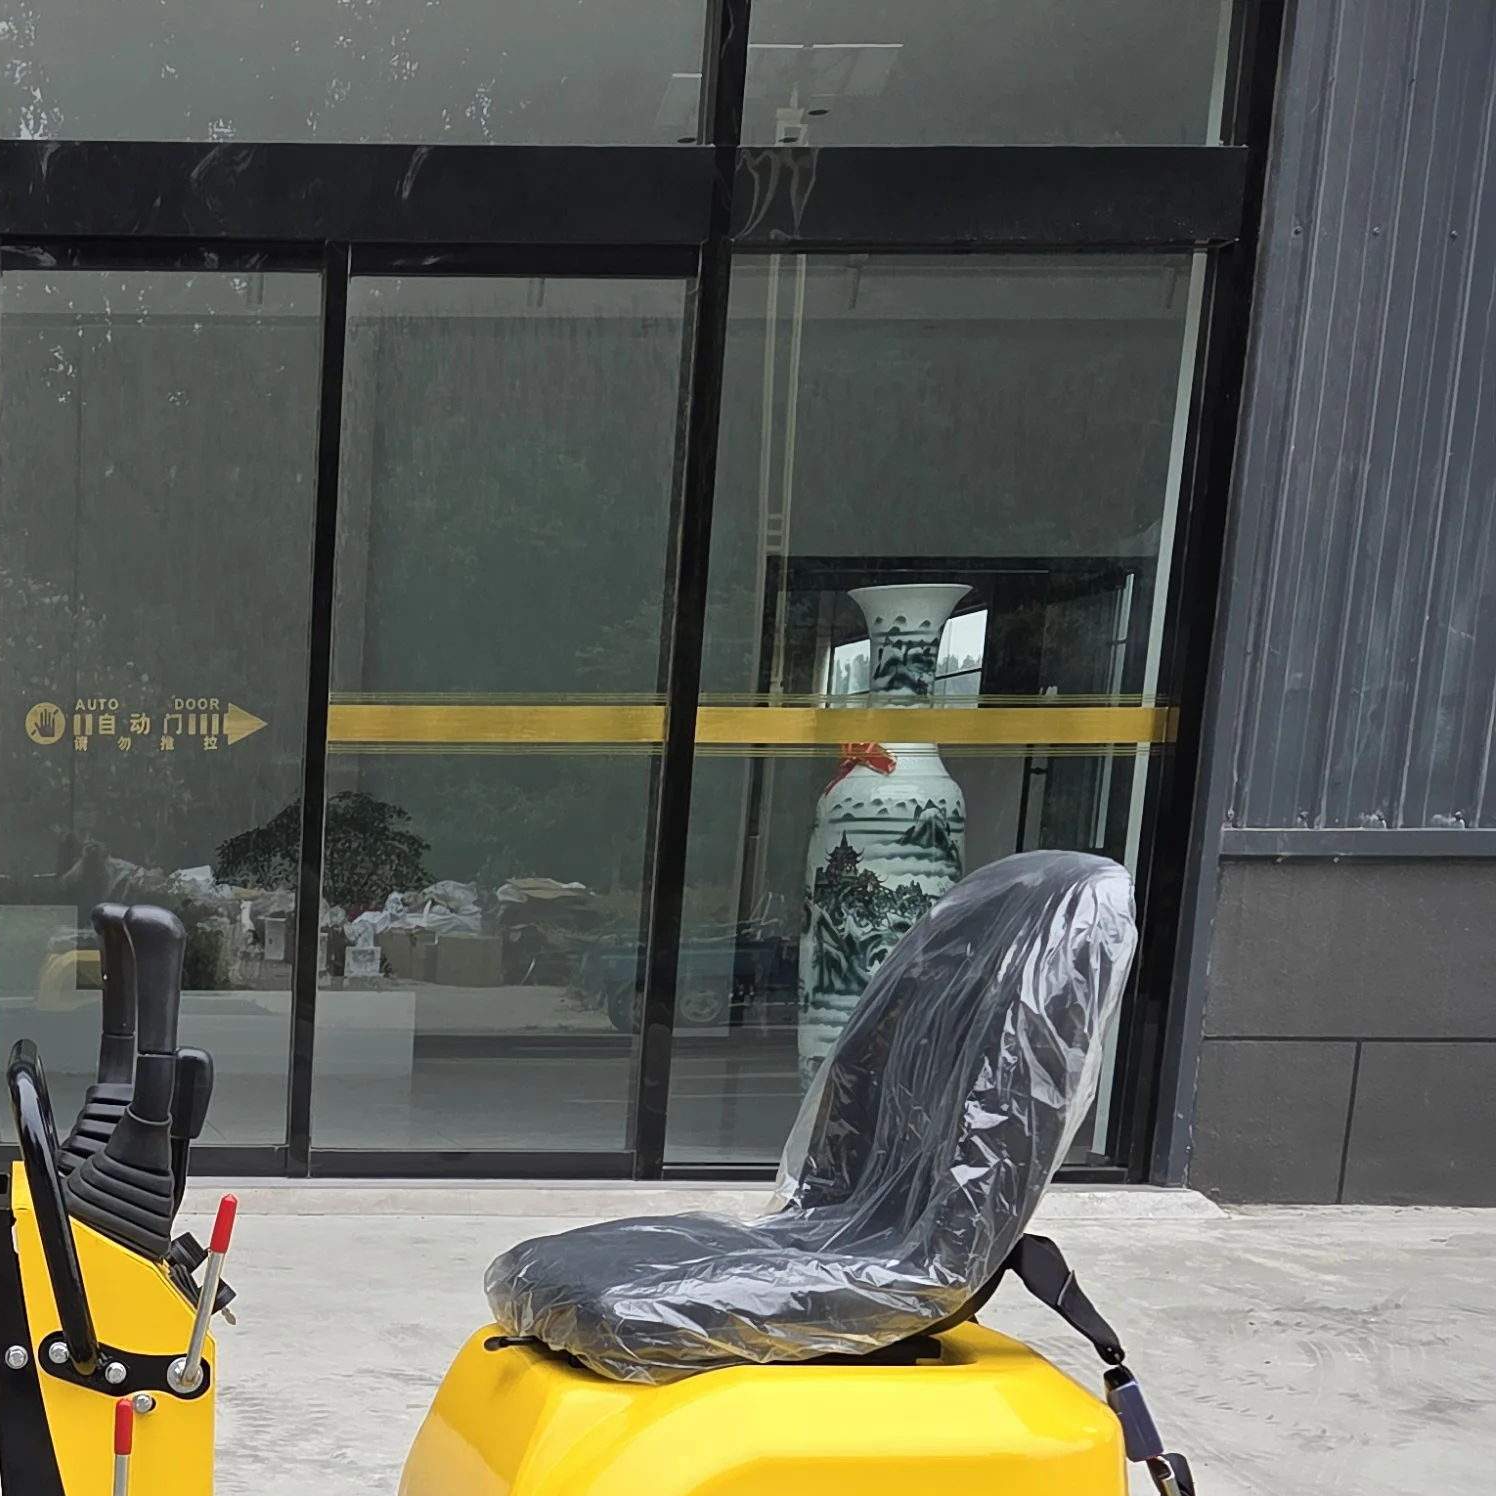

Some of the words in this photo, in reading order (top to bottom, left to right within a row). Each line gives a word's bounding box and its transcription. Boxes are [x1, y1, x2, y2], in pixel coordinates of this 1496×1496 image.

[75, 698, 119, 710] AUTO
[174, 698, 220, 710] DOOR
[98, 712, 182, 735] 自动门
[74, 735, 218, 751] 请勿推拉
